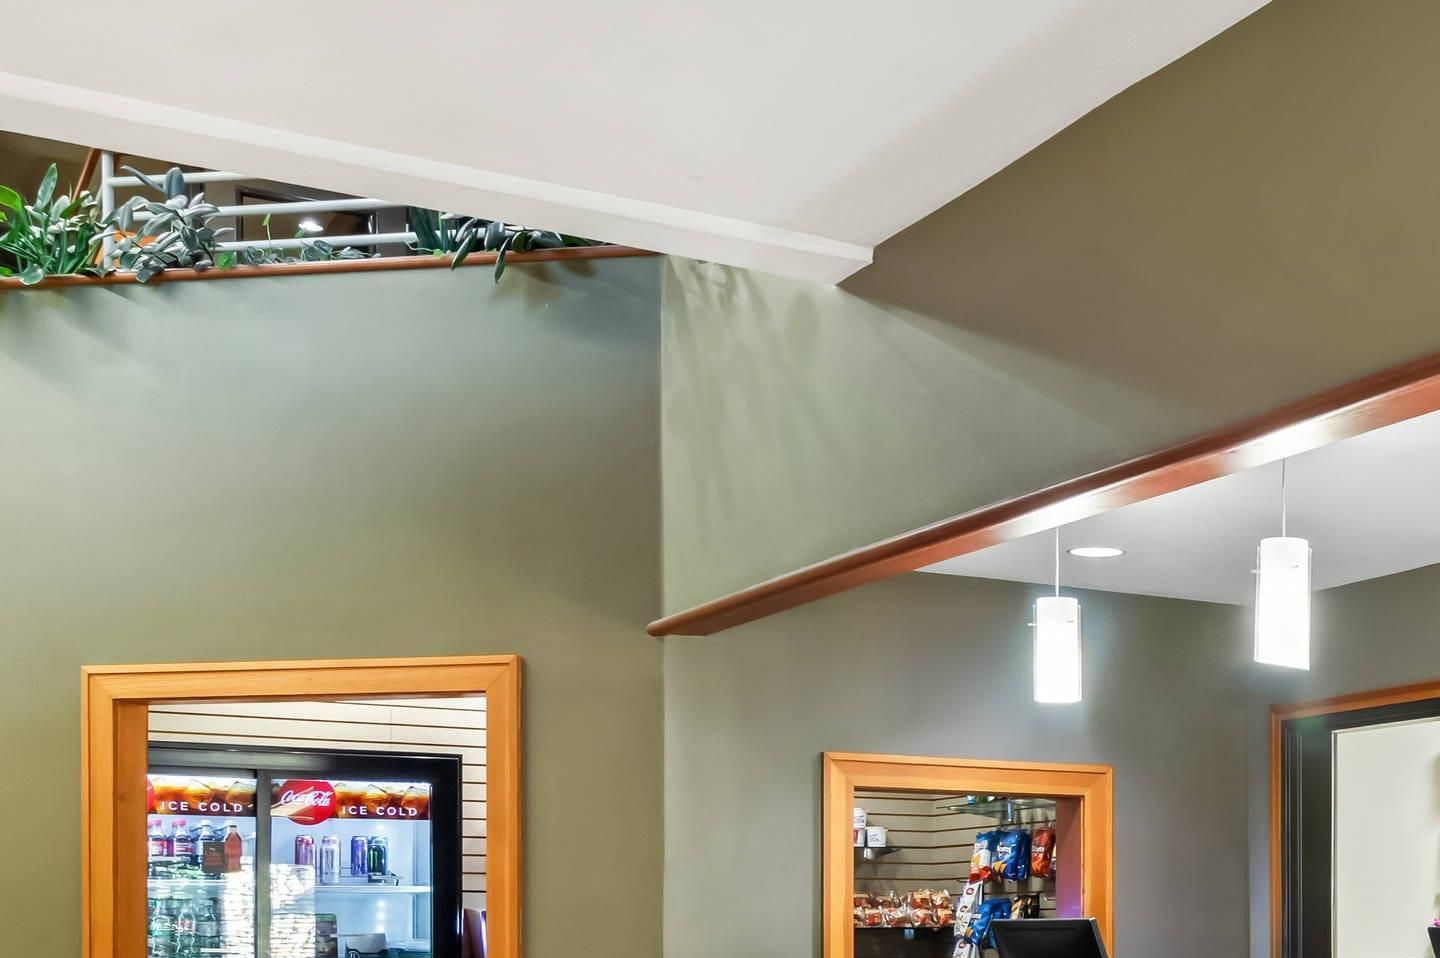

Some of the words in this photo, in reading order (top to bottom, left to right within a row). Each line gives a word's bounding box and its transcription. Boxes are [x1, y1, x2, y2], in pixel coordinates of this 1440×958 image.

[160, 801, 189, 811] ICE
[198, 802, 243, 812] COLD
[342, 806, 367, 815] ICE
[376, 807, 418, 816] COLD
